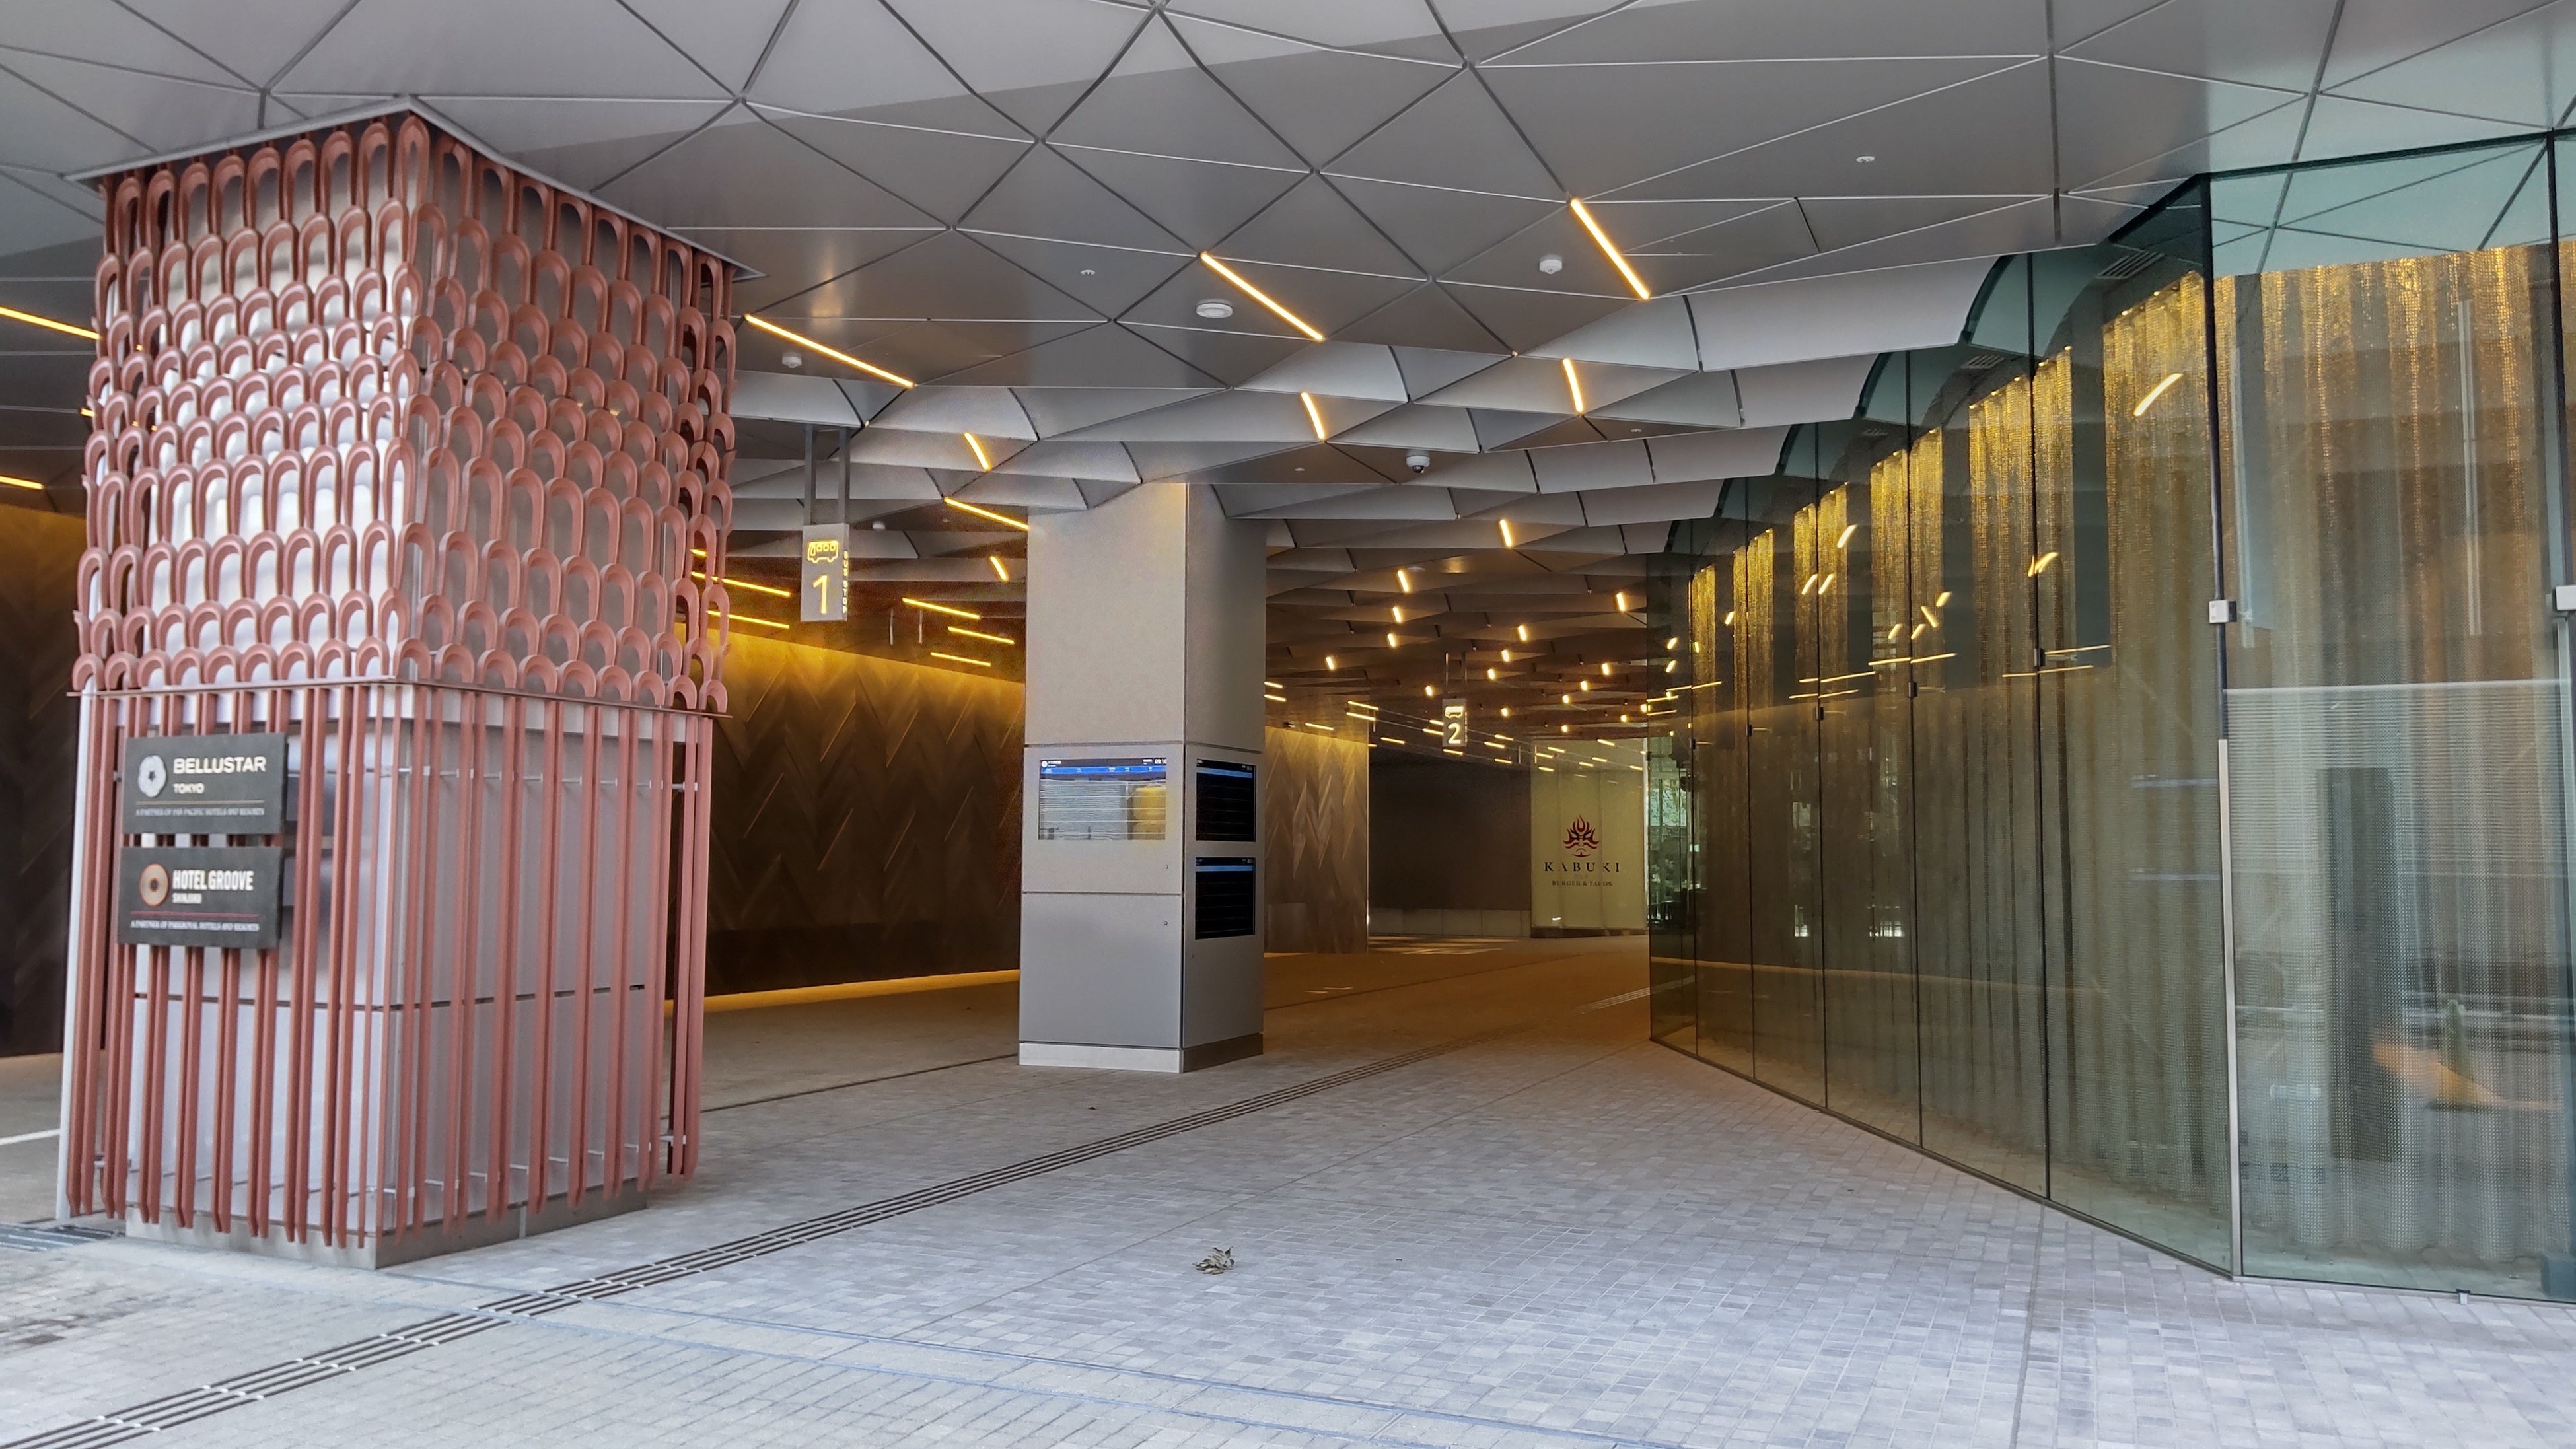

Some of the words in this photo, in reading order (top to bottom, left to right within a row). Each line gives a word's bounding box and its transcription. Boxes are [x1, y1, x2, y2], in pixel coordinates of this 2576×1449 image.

[812, 574, 829, 615] 1
[1448, 723, 1460, 744] 2
[172, 756, 267, 774] BELLUSTAR
[172, 783, 205, 794] TOKYO
[1544, 861, 1620, 872] KABUKI
[172, 870, 207, 890] HOTEL
[208, 870, 254, 891] GROOVE
